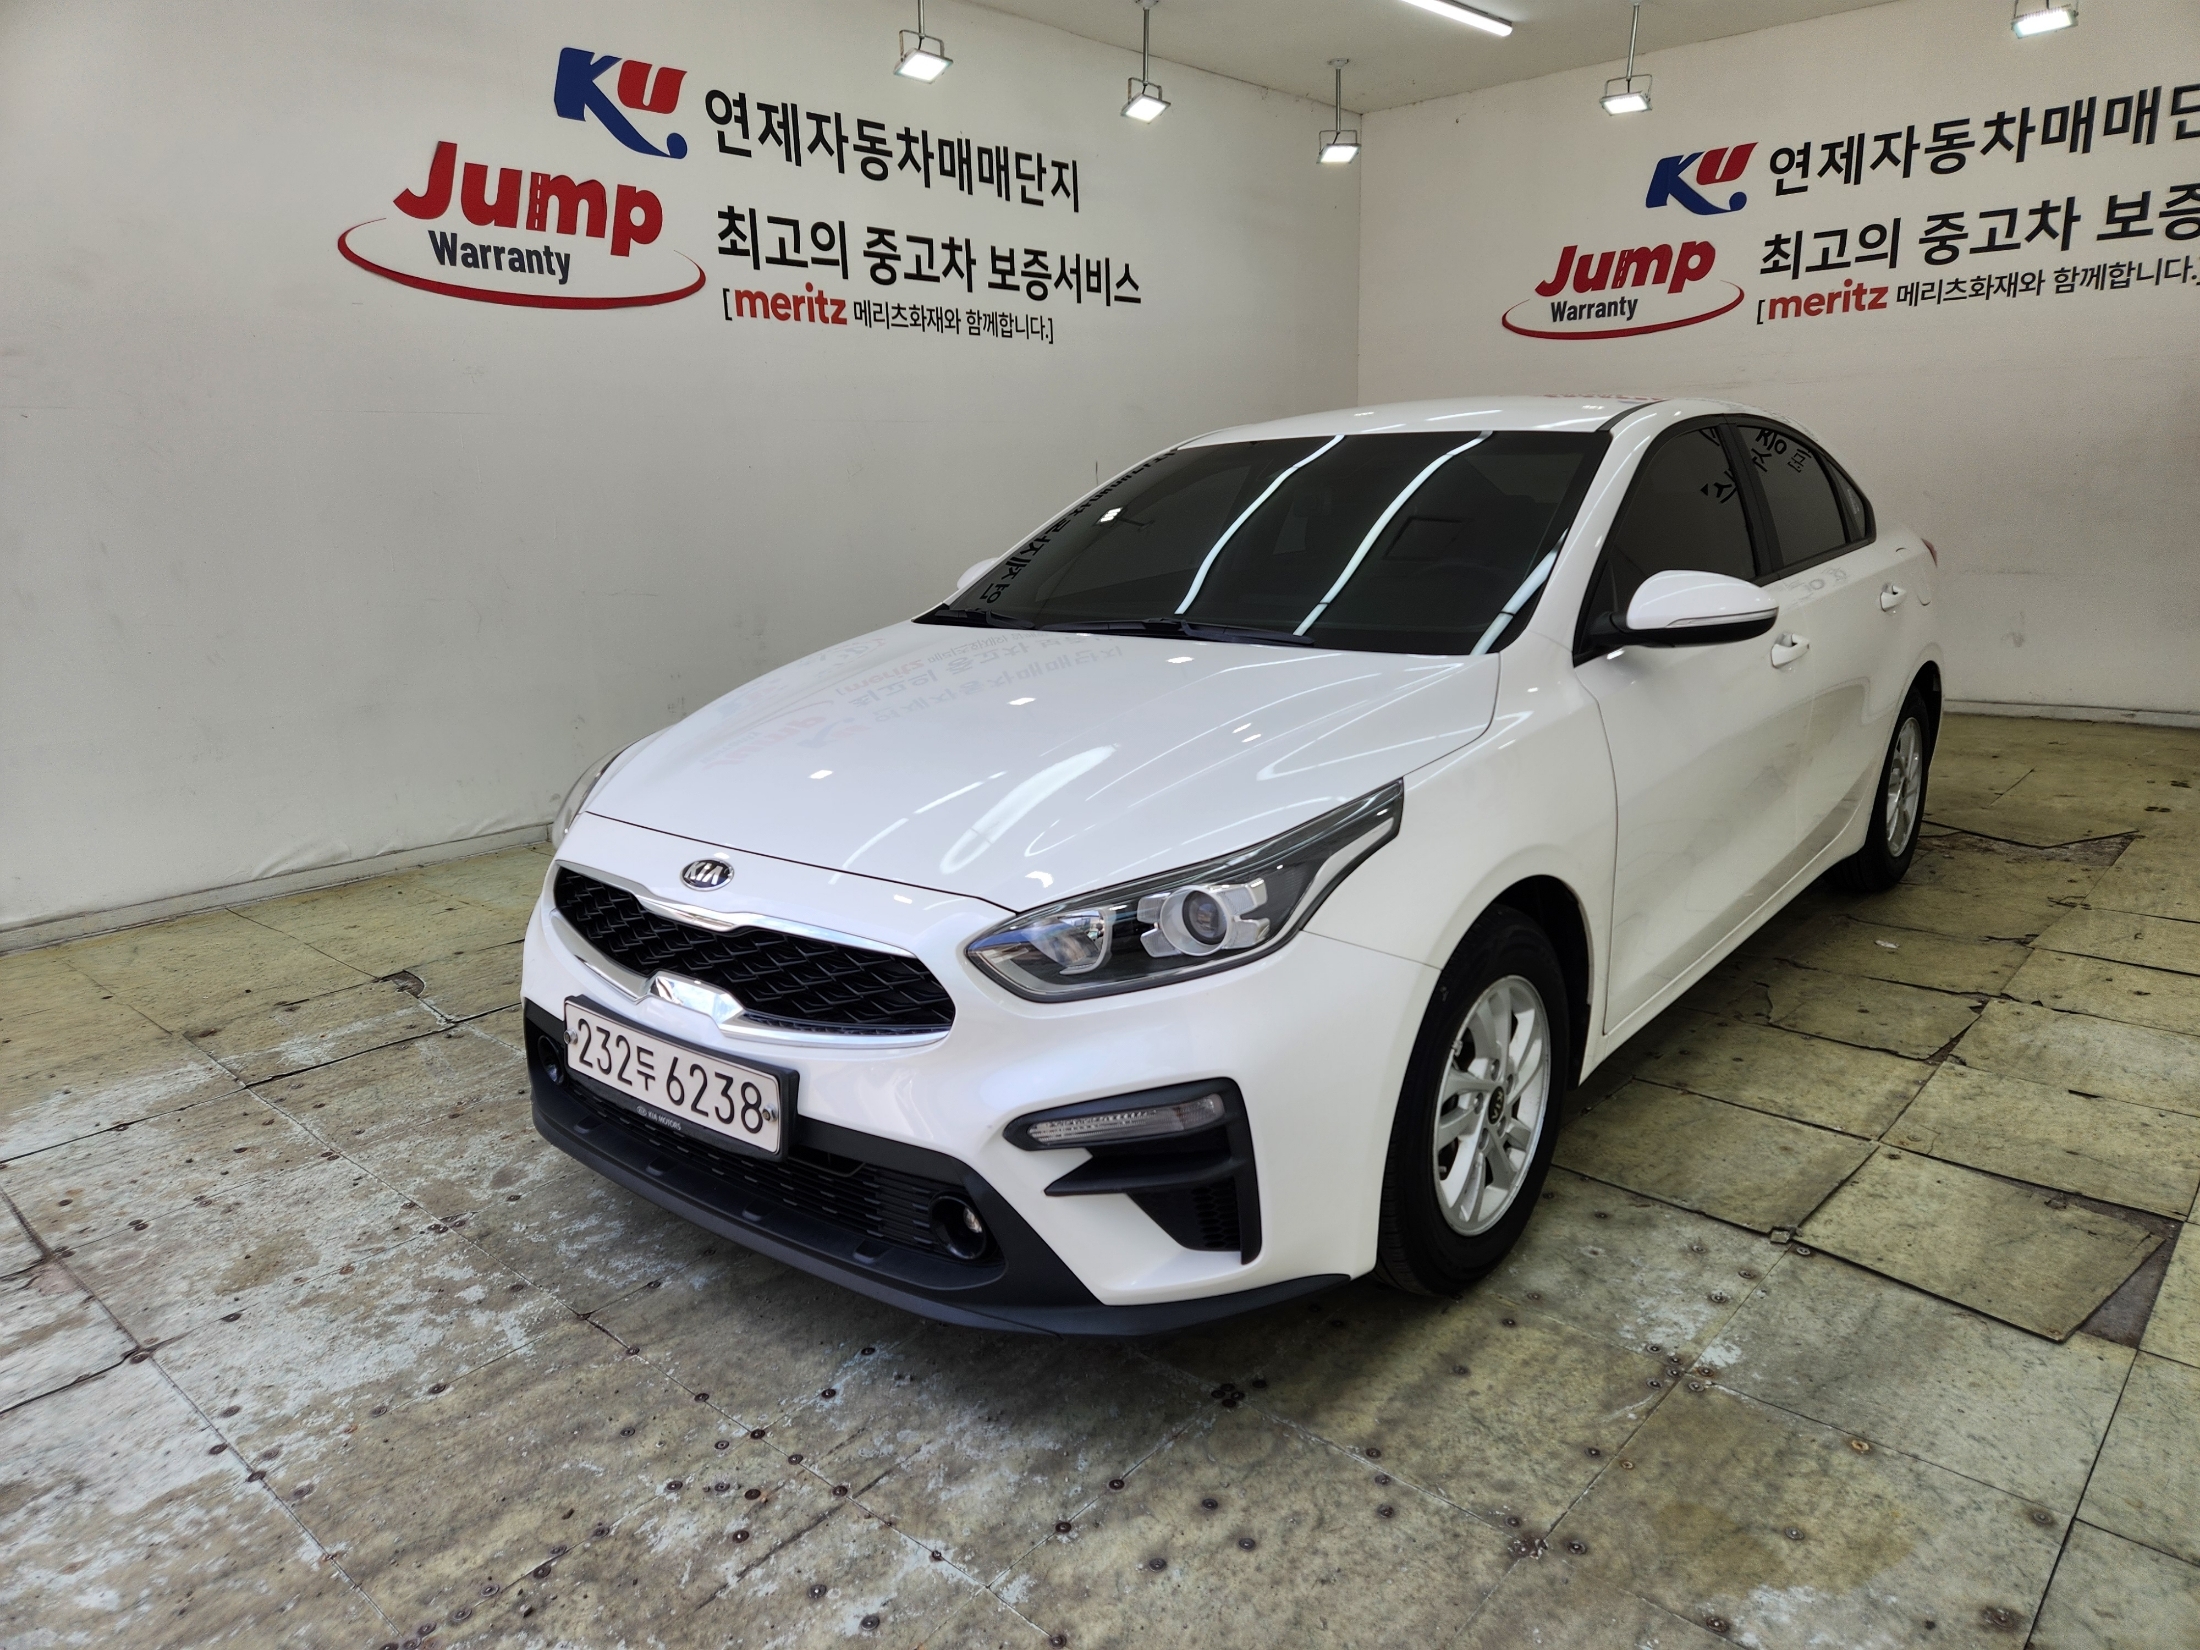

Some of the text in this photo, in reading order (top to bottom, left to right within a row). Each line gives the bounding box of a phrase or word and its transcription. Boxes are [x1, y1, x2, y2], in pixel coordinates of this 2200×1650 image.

[704, 89, 1080, 213] 연제자동차매매단지
[393, 140, 663, 257] Jump
[428, 230, 571, 285] Warranty
[717, 205, 1142, 307] 최고의 중고차 보증서비스
[1759, 217, 1901, 280] 최고의
[1919, 196, 2081, 266] 중고차
[1535, 241, 1716, 297] Jump
[1896, 269, 2046, 307] 메리츠화재와
[853, 300, 962, 335] 메리츠화재와
[965, 308, 1054, 345] 함께합니다.]
[1550, 296, 1638, 323] Warranty
[683, 861, 724, 886] KIA
[577, 1018, 764, 1134] 232두 6238
[658, 1115, 682, 1131] MOTORS
